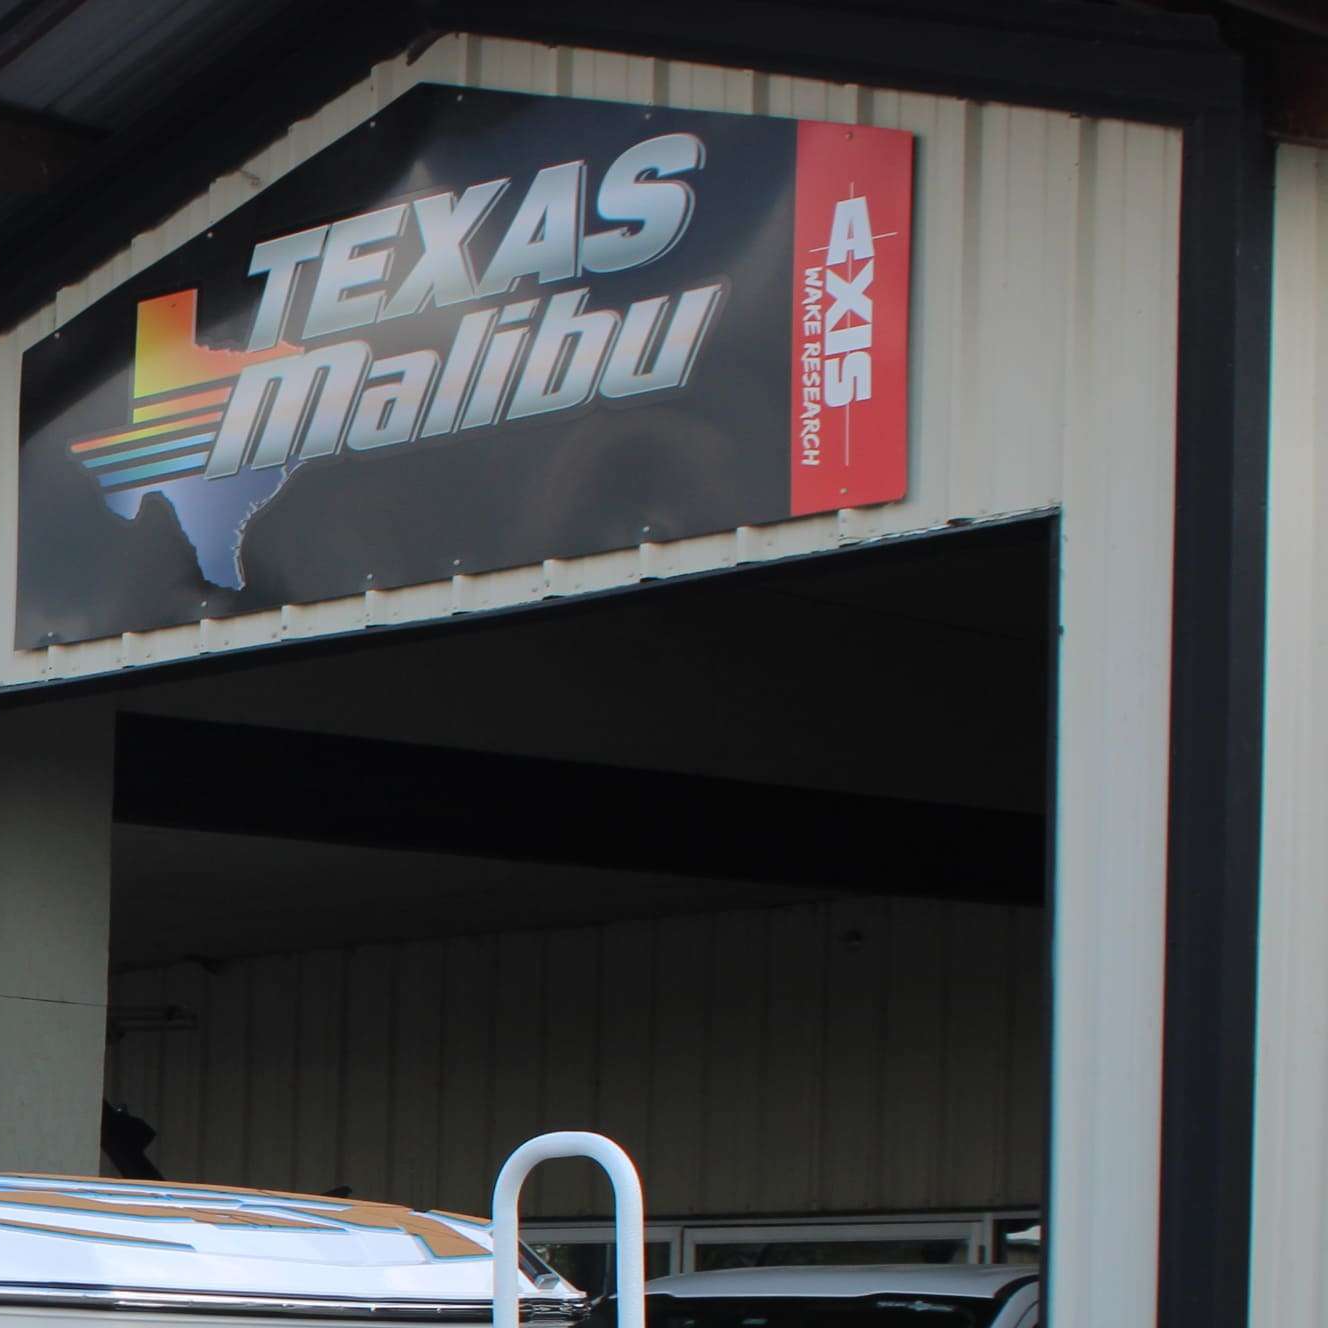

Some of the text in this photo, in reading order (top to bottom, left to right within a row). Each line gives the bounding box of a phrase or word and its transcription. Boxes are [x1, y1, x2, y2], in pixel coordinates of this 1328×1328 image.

[247, 132, 707, 353] TEXAS
[825, 196, 875, 408] AXIS
[204, 282, 723, 481] Malibu
[800, 266, 823, 467] WAKE RESEARCH
